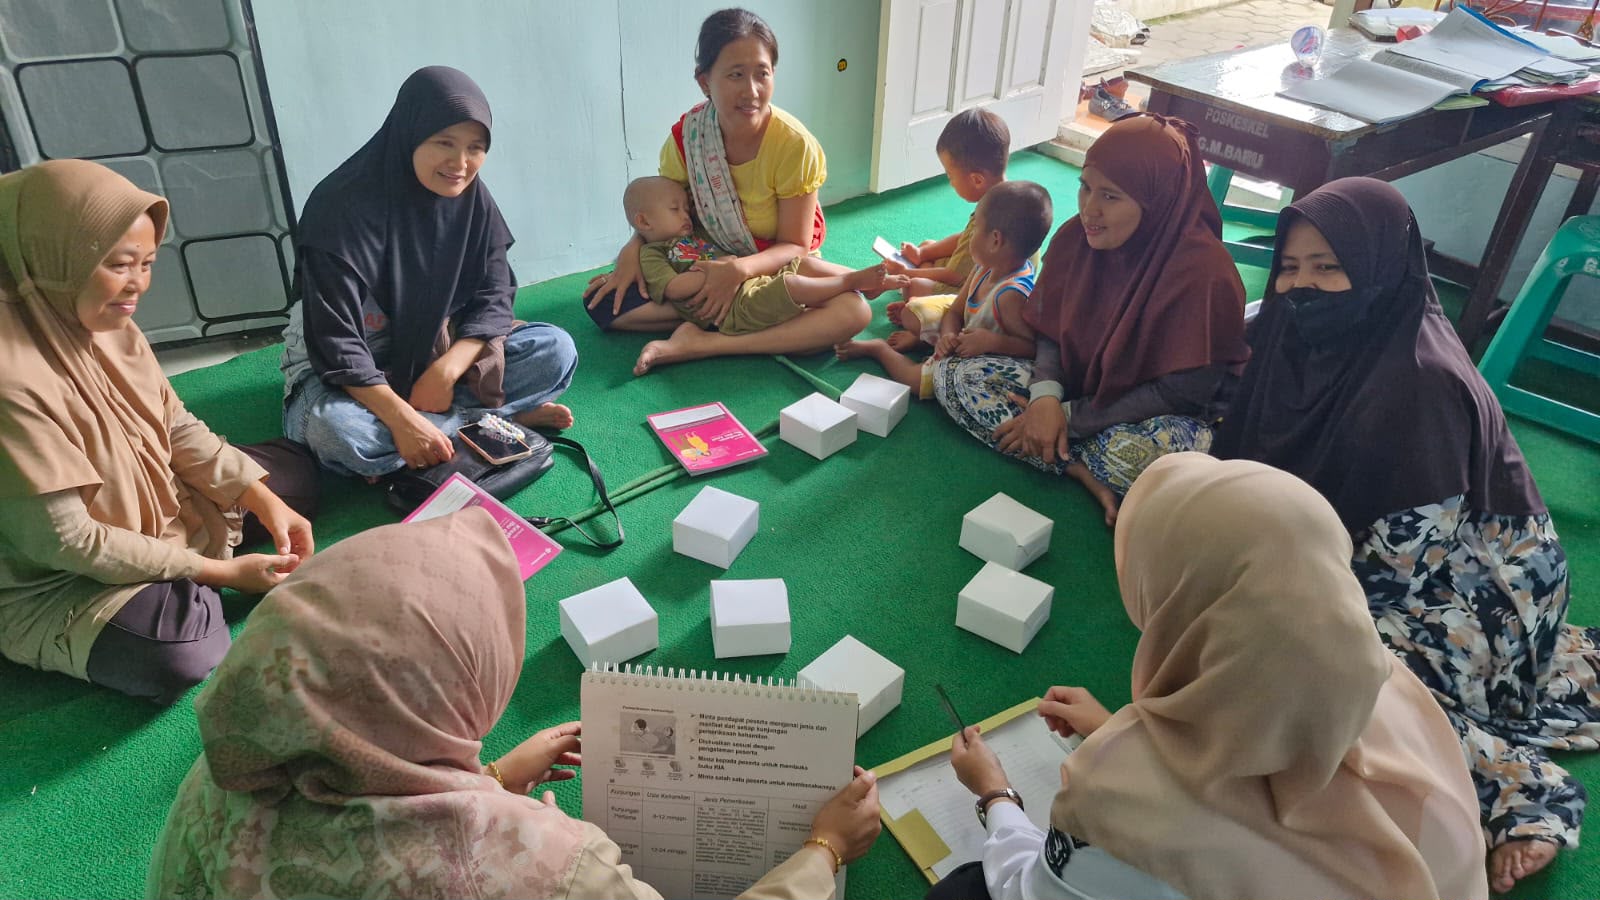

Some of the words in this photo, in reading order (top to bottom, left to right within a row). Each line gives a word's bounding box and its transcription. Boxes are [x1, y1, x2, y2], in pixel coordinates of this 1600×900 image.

[1205, 107, 1269, 138] POSKESKEL
[717, 716, 744, 724] pendapat
[746, 718, 768, 726] peserta
[769, 720, 798, 729] mengenai
[698, 729, 736, 737] pemeriksaan
[738, 732, 768, 740] kehamilan
[757, 726, 788, 735] kunjungan
[698, 746, 734, 754] pengalaman
